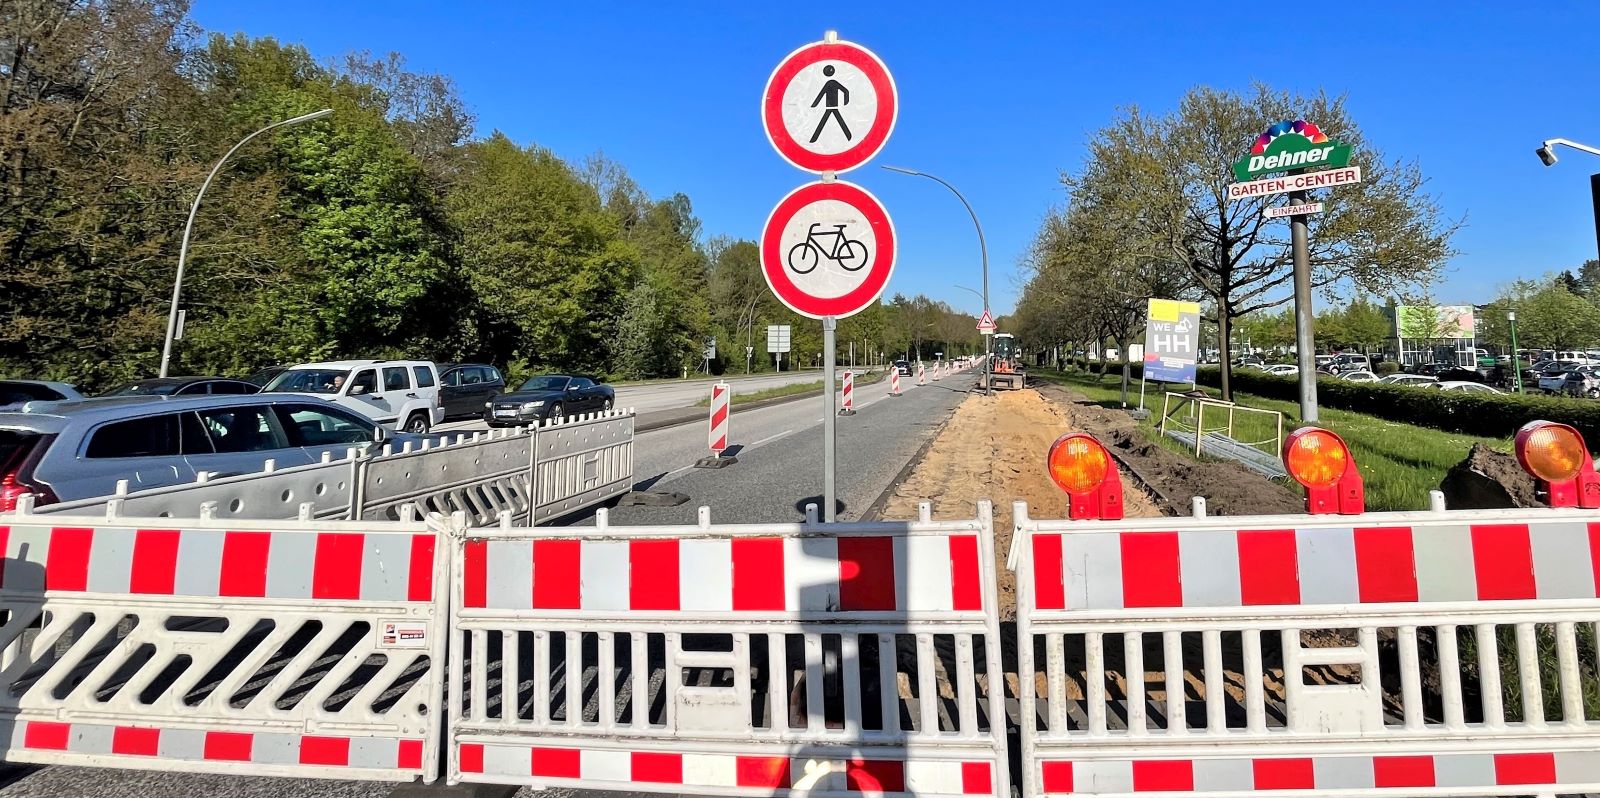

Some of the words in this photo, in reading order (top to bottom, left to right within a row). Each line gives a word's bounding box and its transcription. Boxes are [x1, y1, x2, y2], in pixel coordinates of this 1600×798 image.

[1248, 146, 1334, 172] Dehner
[1272, 204, 1318, 216] EINFAHRT
[1153, 323, 1171, 332] WE
[1153, 334, 1191, 353] HH
